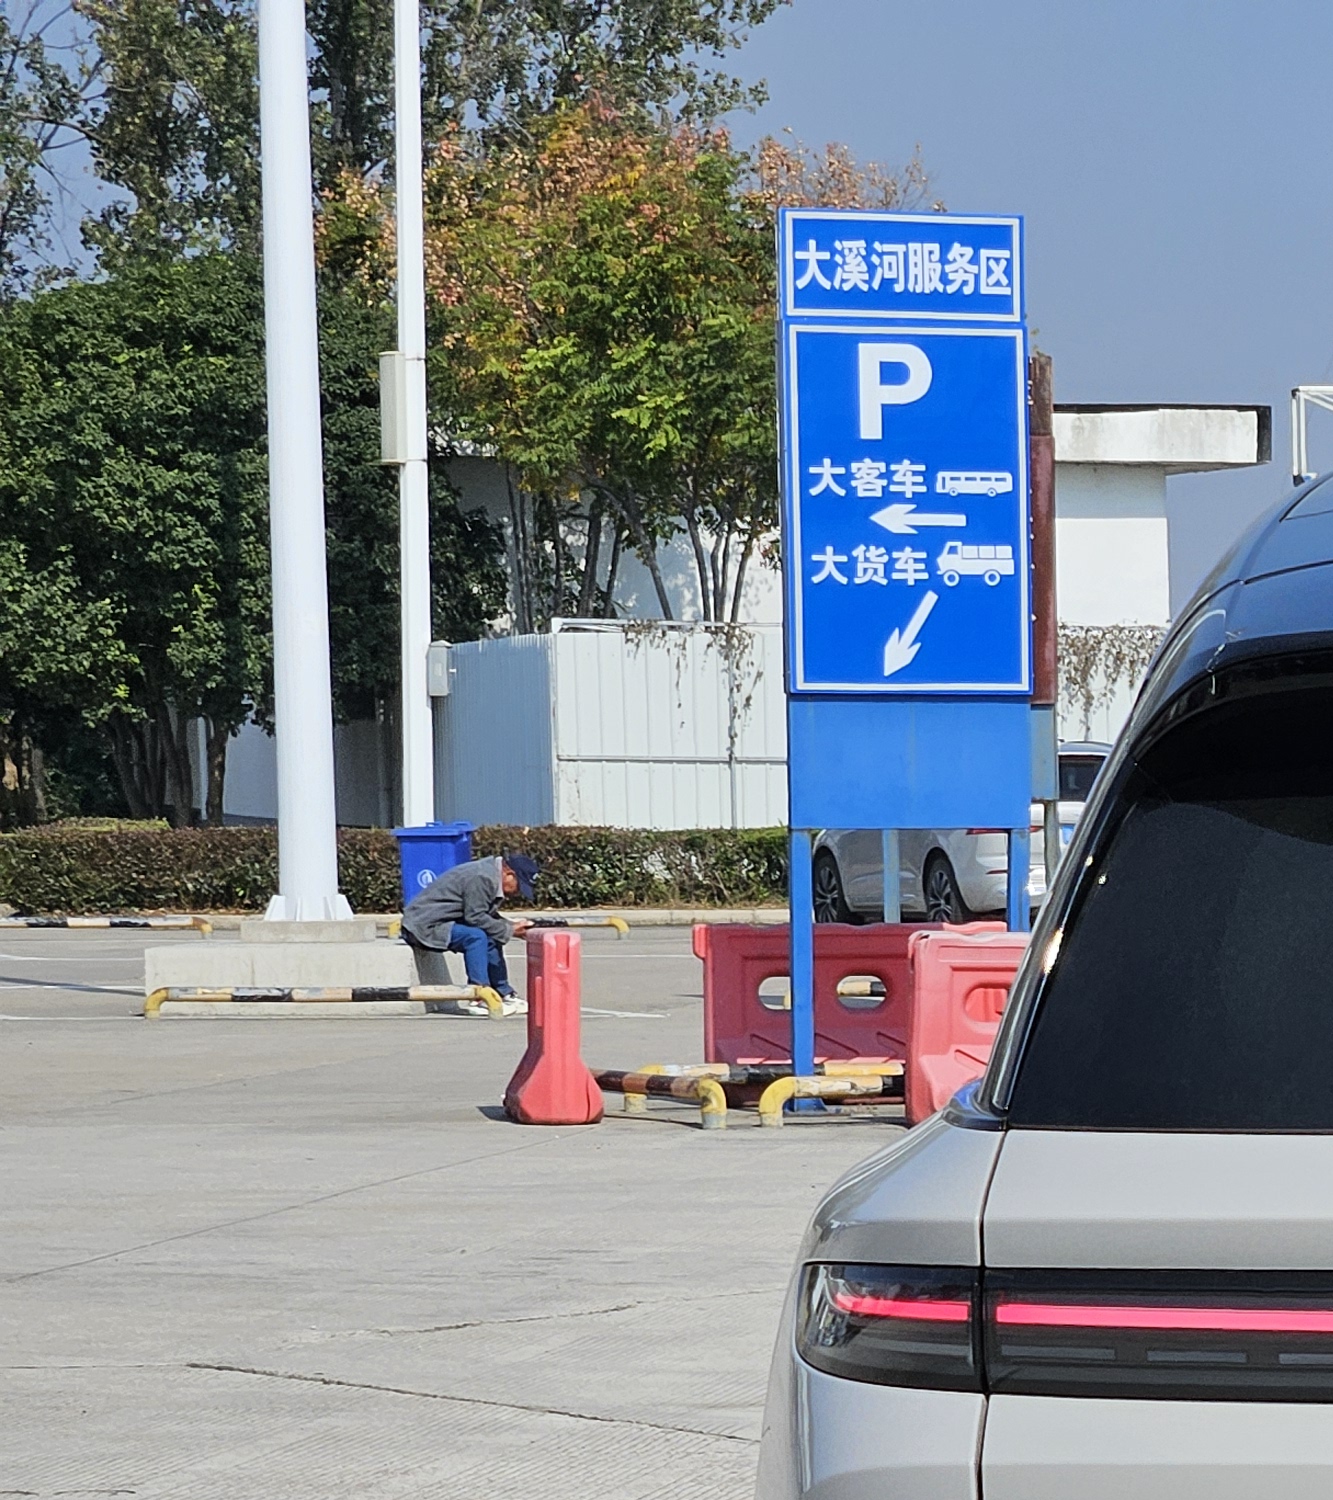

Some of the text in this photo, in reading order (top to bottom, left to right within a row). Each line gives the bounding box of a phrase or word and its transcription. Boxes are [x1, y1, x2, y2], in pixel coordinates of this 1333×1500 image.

[795, 239, 1012, 296] 大溪河服务区
[858, 342, 933, 440] P
[808, 458, 928, 499] 大客车
[810, 543, 930, 587] 大货车
